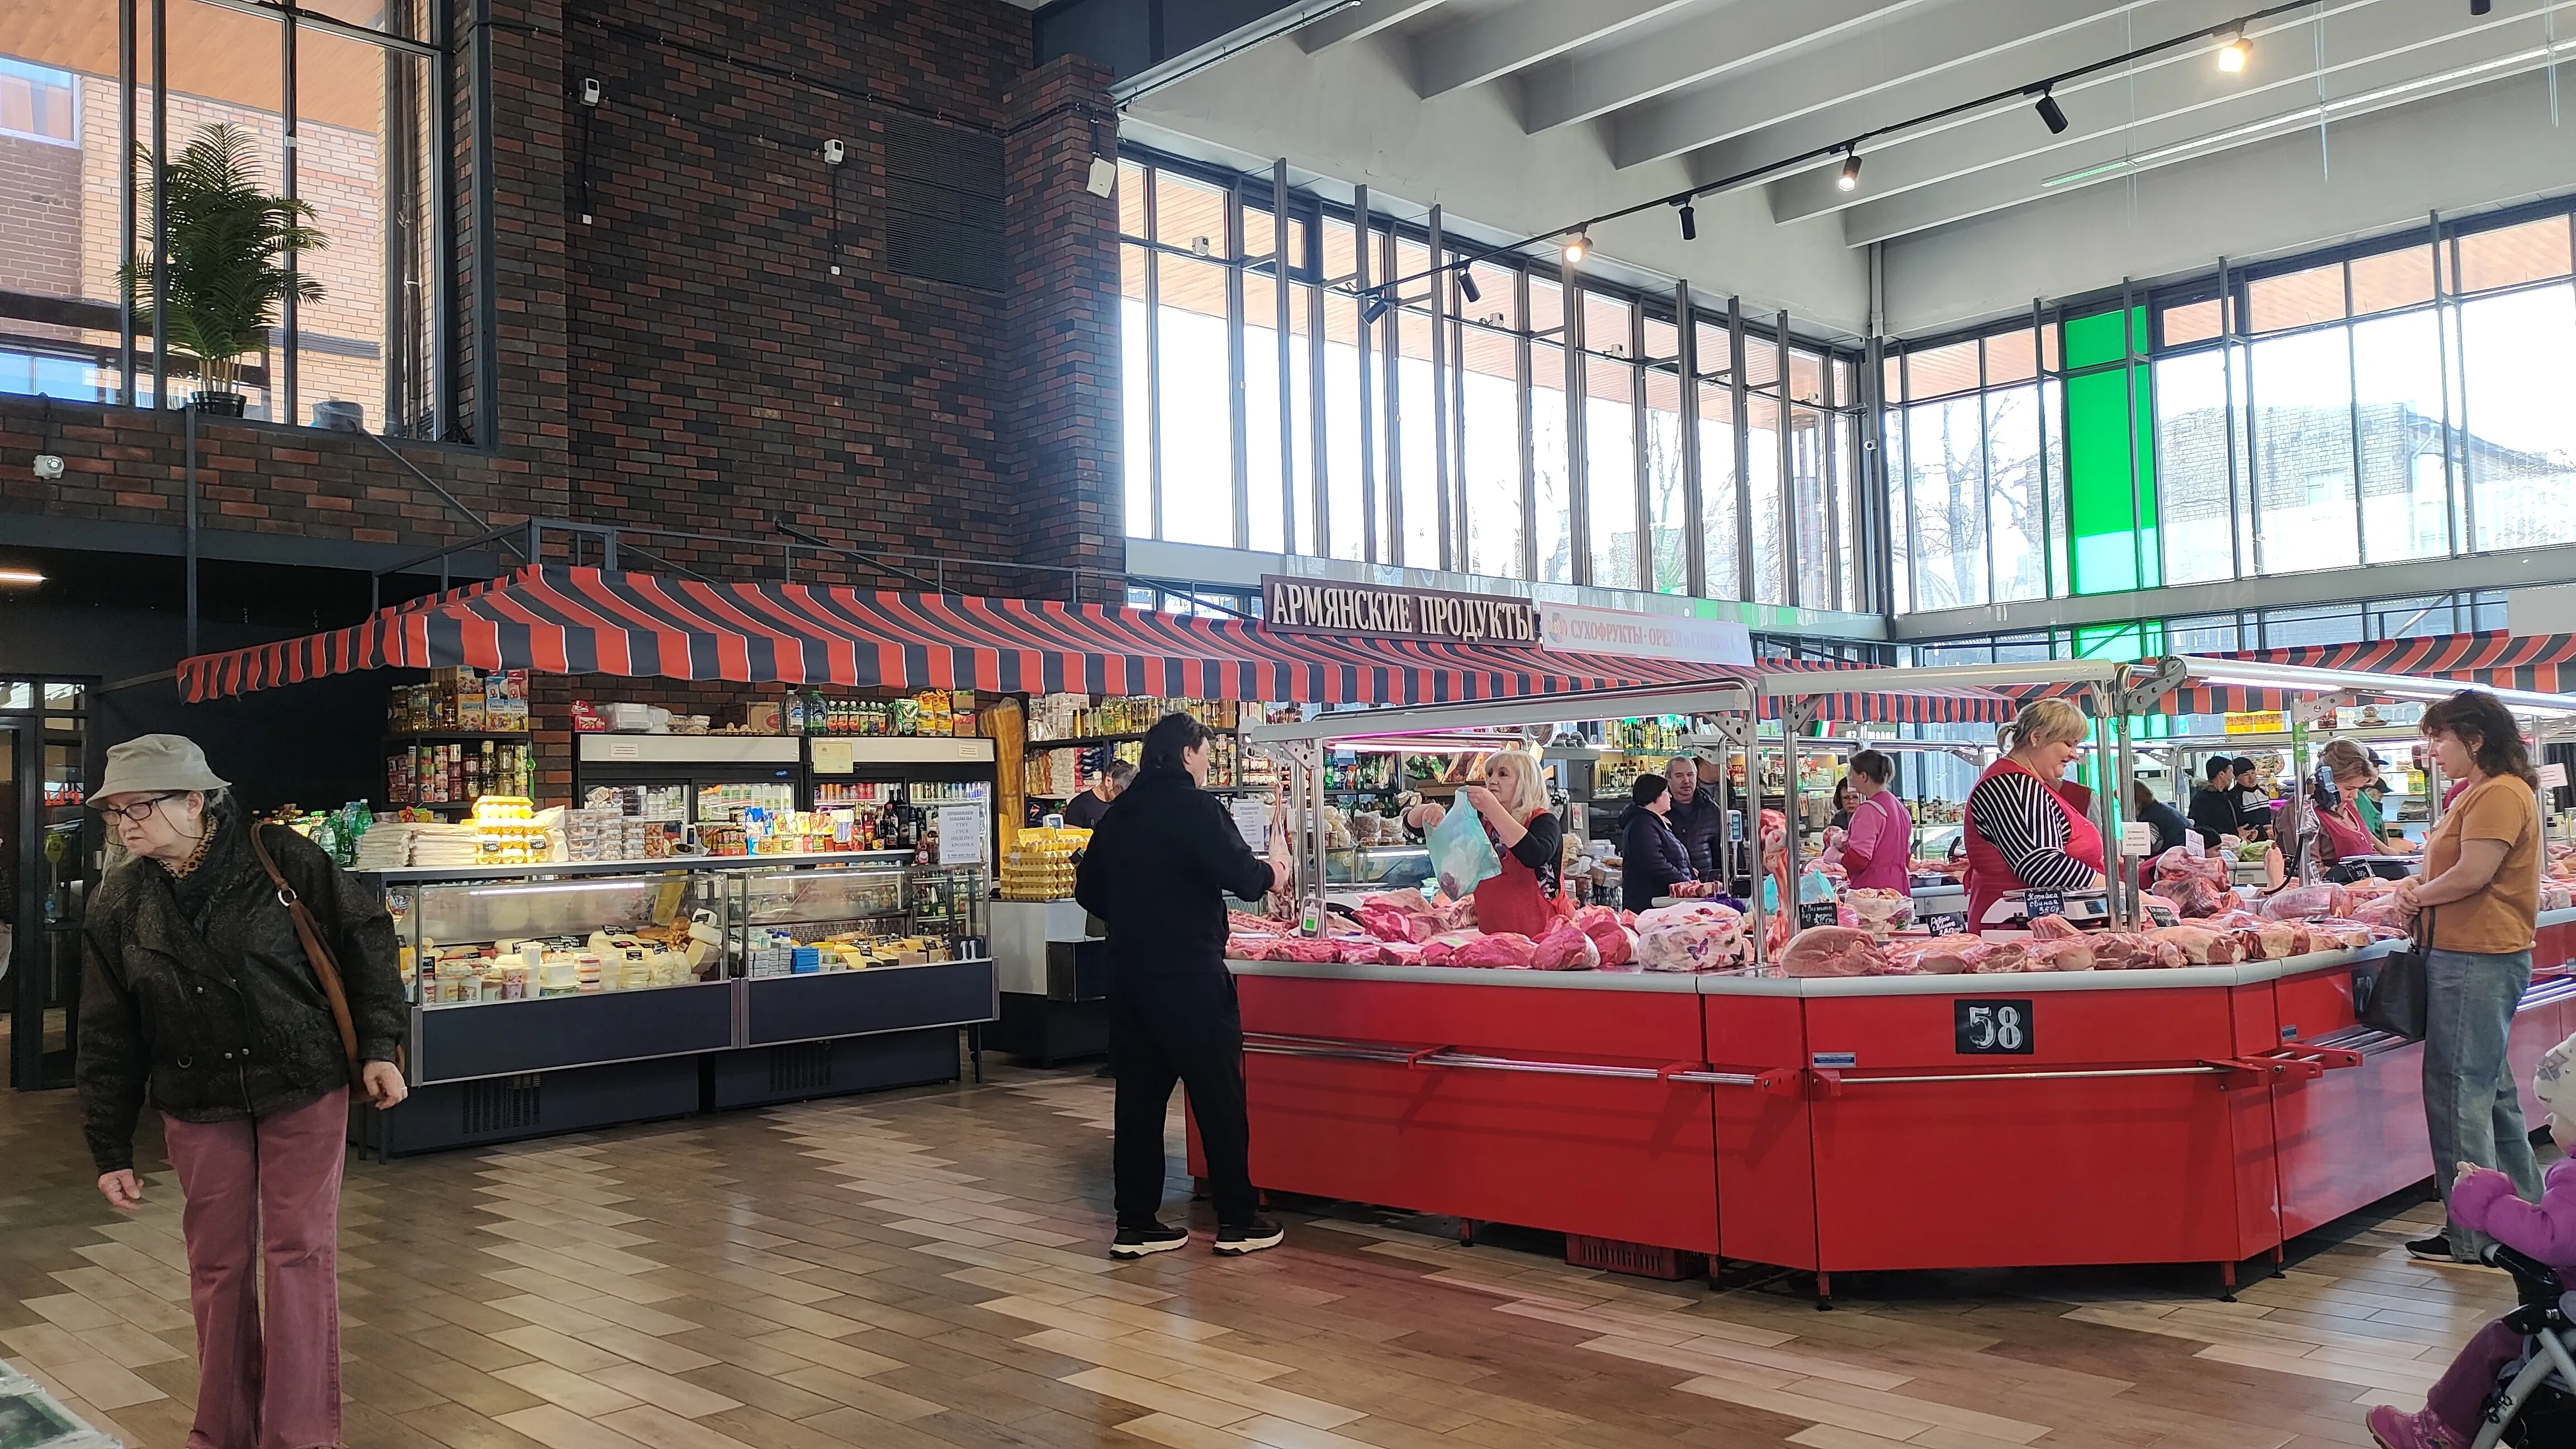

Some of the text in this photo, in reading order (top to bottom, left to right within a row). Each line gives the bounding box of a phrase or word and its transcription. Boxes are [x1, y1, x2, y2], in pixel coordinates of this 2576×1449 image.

[1271, 582, 1535, 642] АРМЯНСКИЕ ПРОДУКТЫ
[1571, 619, 1643, 645] СУХОФРУКТЫ
[1648, 627, 1682, 647] ОРЕХИ
[1931, 916, 1950, 927] Ребро
[960, 940, 977, 961] 11
[1968, 1006, 2023, 1050] 58
